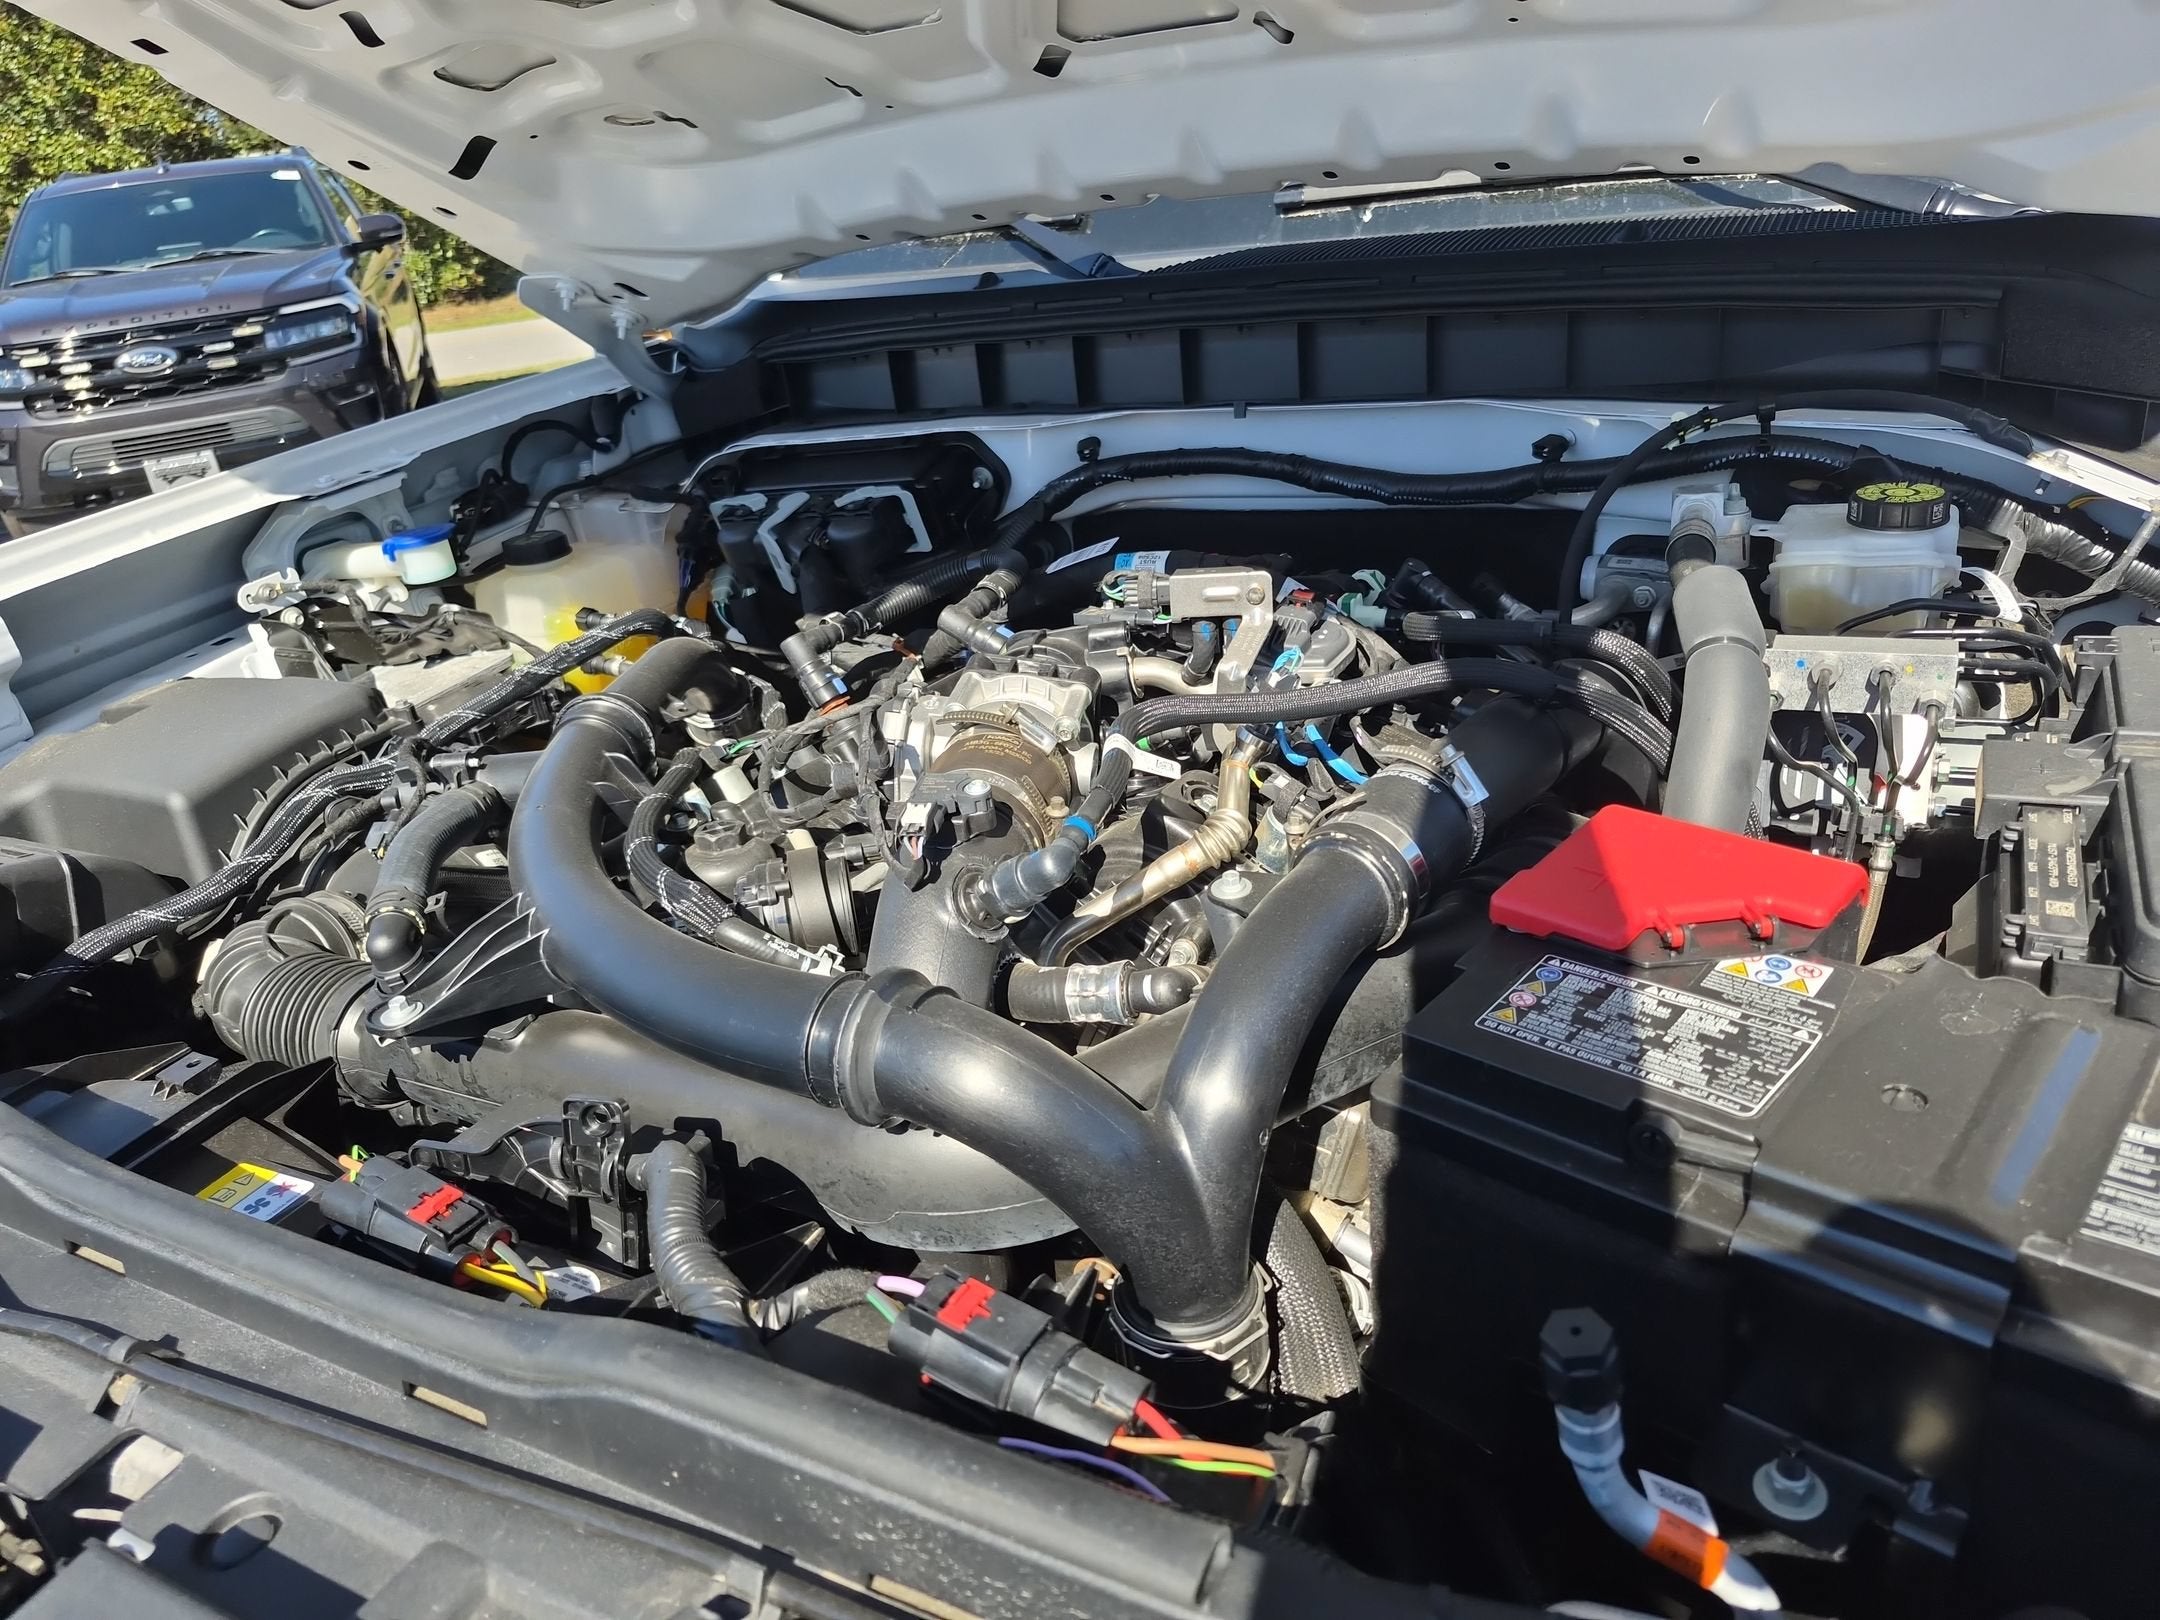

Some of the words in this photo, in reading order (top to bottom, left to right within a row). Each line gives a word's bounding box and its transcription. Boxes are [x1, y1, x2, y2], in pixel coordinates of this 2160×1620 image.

[42, 304, 232, 336] EXPEDITION
[1560, 961, 1638, 988] DANGER/POISON
[1658, 989, 1742, 1018] PELIGRO/VENENO
[1483, 1020, 1498, 1029] DO
[1499, 1024, 1516, 1034] NOT
[1517, 1029, 1540, 1043] OPEN.
[1544, 1038, 1557, 1048] NE
[1558, 1043, 1576, 1055] PAS
[1577, 1049, 1613, 1066] OUVRIR.
[1617, 1063, 1633, 1073] NO
[1632, 1067, 1647, 1078] LA
[1646, 1072, 1675, 1088] ABRA.
